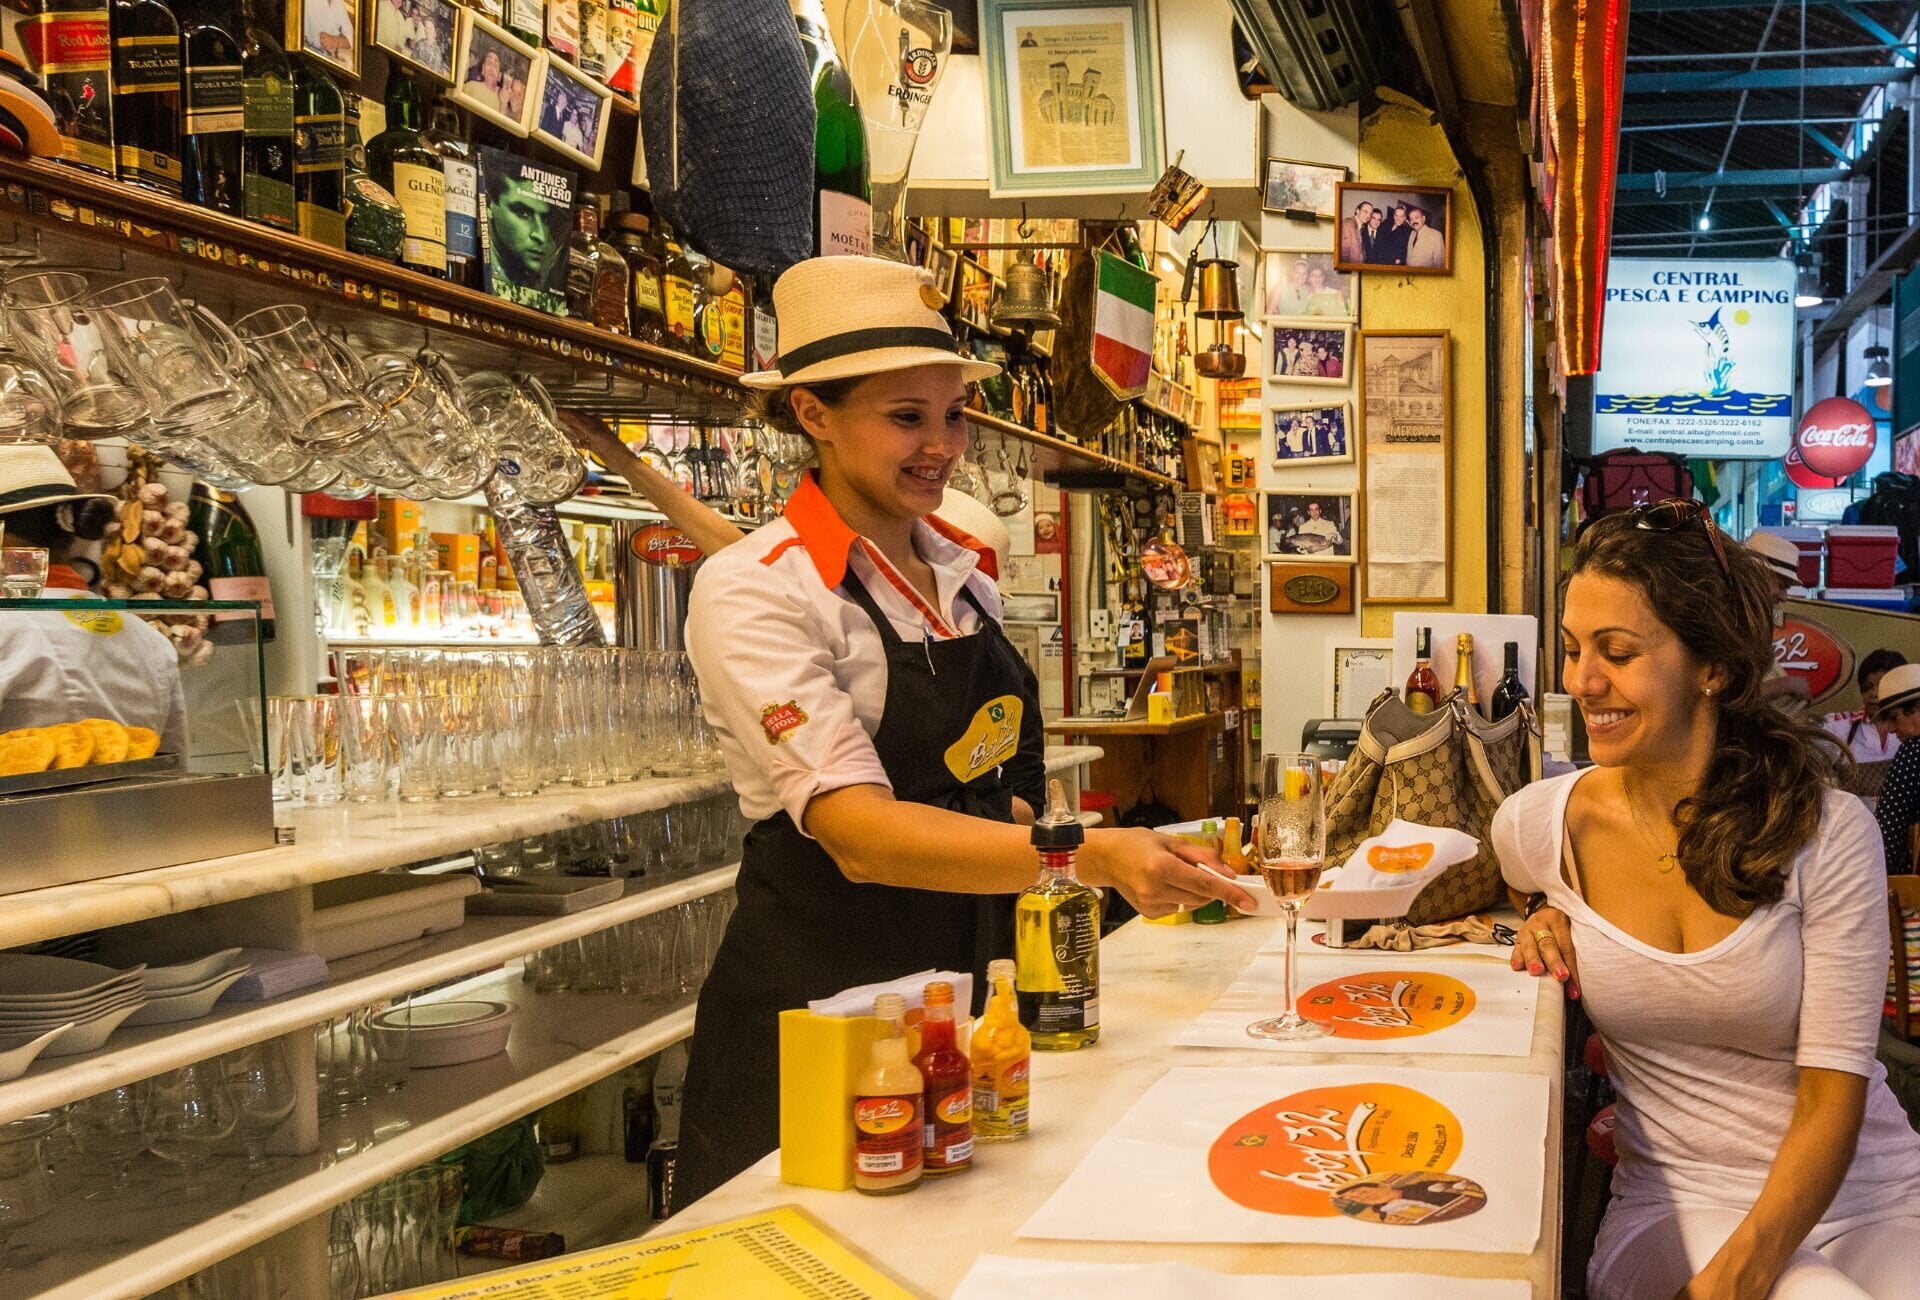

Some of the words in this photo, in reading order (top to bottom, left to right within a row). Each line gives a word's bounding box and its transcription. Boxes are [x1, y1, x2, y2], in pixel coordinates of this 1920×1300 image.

[60, 35, 83, 47] Red
[128, 60, 158, 69] BLACK
[194, 81, 220, 89] DOUBLE
[521, 165, 568, 189] ANTUNES
[532, 180, 572, 202] SEVERO
[461, 223, 470, 235] 12
[480, 223, 489, 249] SEVERO
[1652, 271, 1744, 286] CENTRAL
[1606, 288, 1671, 302] PESCA
[1678, 289, 1689, 302] E
[1697, 289, 1789, 304] CAMPING
[1623, 437, 1765, 446] www.centralpescaecamping.com.br
[1800, 424, 1871, 447] Coca-Cola
[1297, 580, 1327, 598] BAR
[880, 1100, 900, 1115] 32
[1276, 1107, 1347, 1142] 32
[484, 1281, 510, 1293] do
[515, 1272, 554, 1286] Box
[560, 1265, 583, 1276] 32
[589, 1255, 631, 1268] com
[636, 1242, 682, 1258] 100g
[685, 1236, 708, 1246] de
[712, 1219, 776, 1239] recheio
